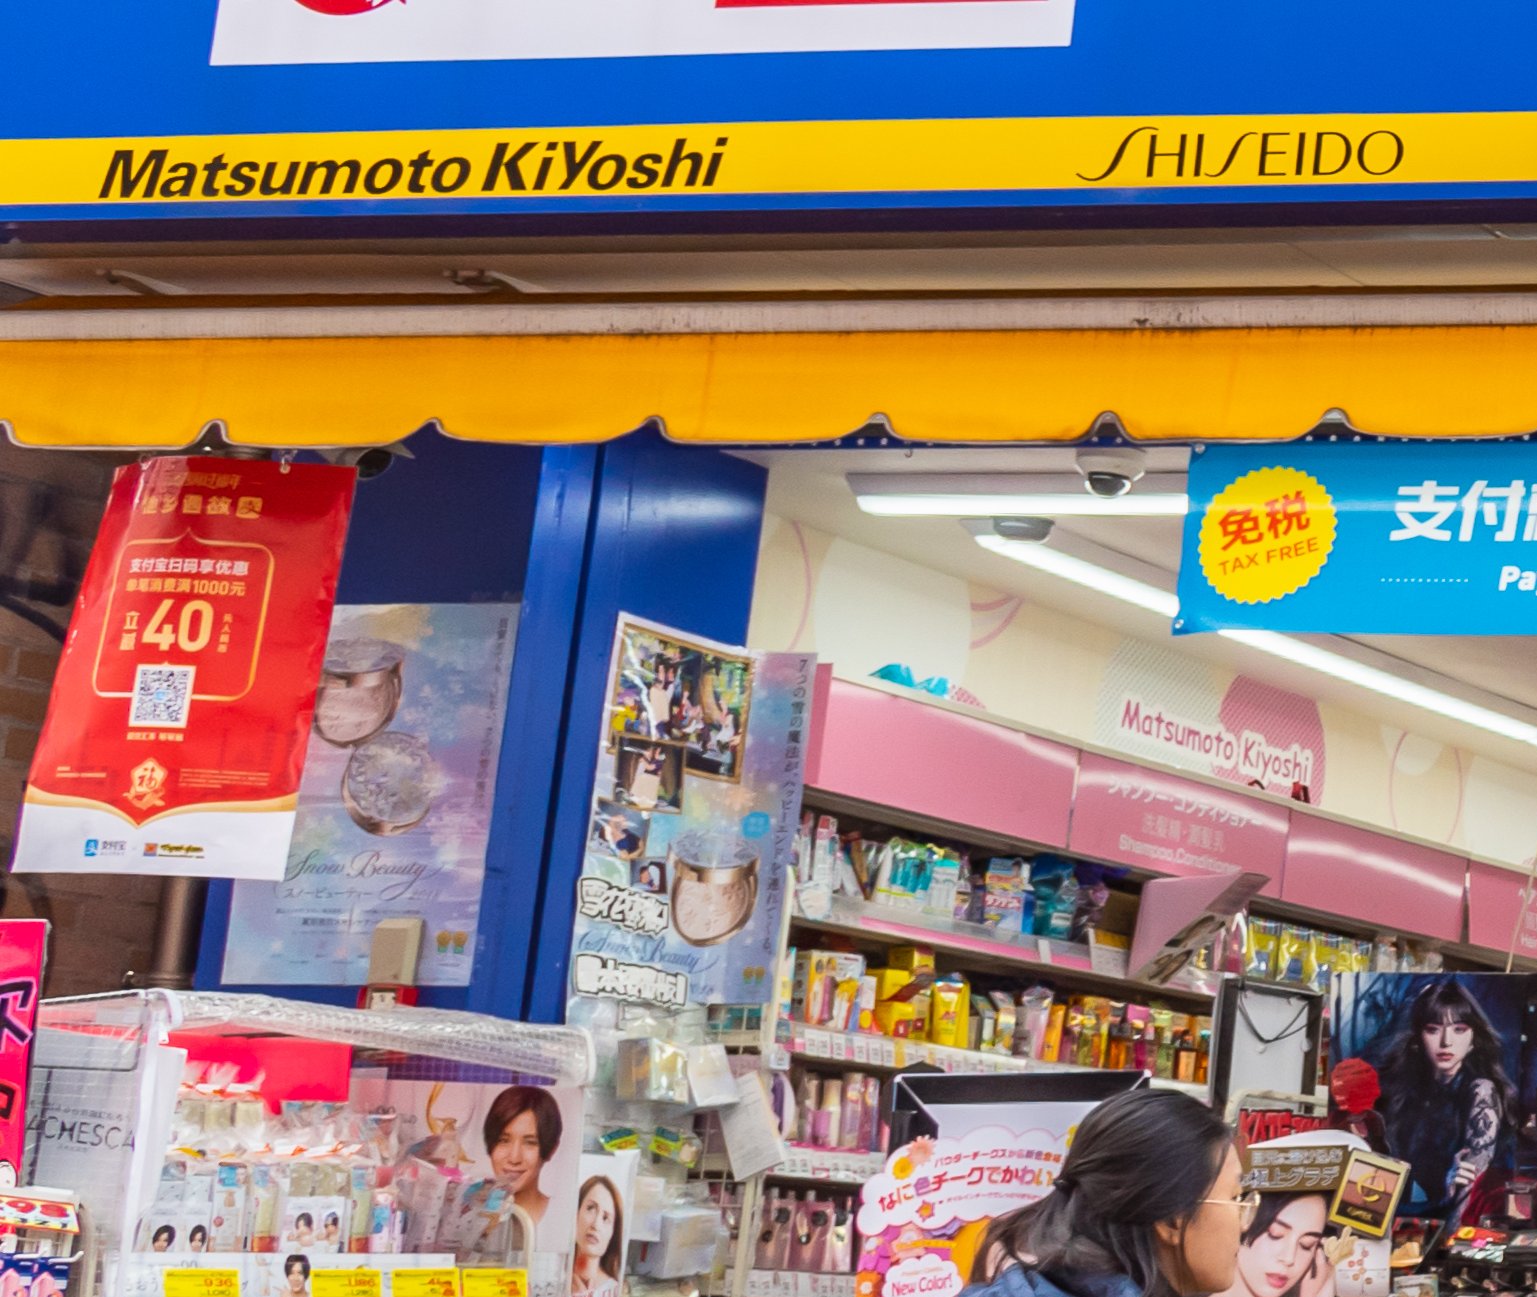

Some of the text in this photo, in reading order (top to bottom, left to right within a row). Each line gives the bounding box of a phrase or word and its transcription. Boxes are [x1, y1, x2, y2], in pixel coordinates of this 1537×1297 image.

[98, 138, 728, 199] Matsumoto KiYoshi
[1075, 125, 1405, 183] SHISEIDO
[1218, 490, 1311, 552] 免税
[1219, 537, 1320, 576] TAX FREE
[142, 598, 215, 653] 40
[1121, 699, 1310, 783] Matsumoto Kiyoshi
[891, 1273, 953, 1297] New Color!
